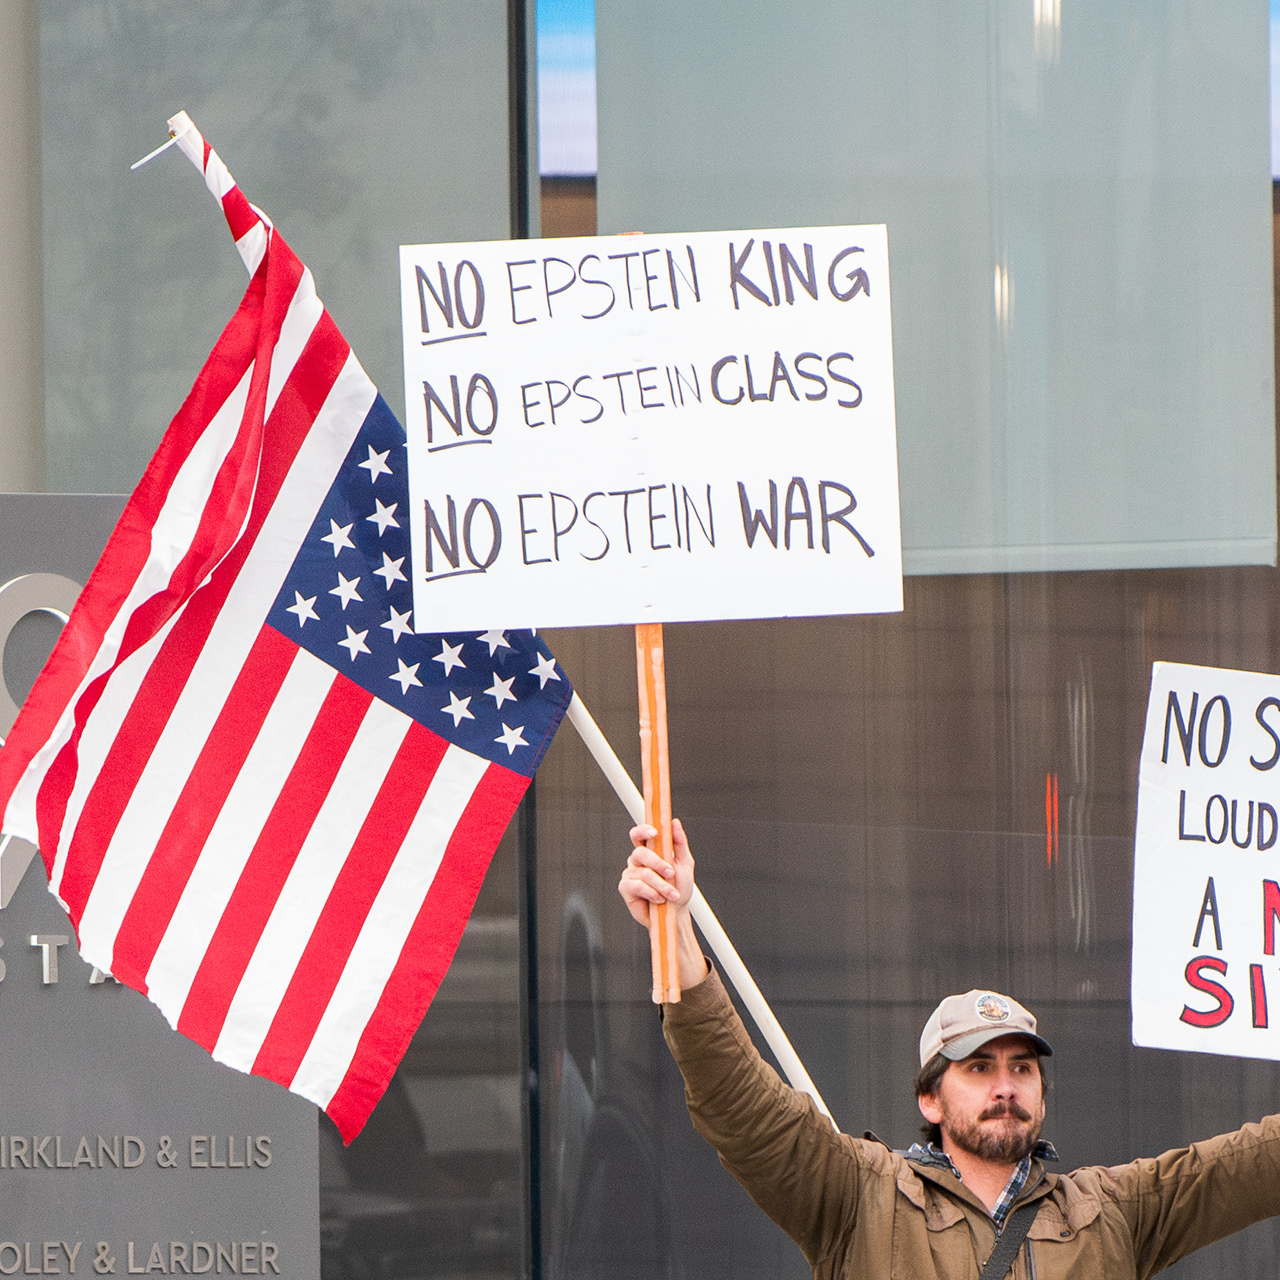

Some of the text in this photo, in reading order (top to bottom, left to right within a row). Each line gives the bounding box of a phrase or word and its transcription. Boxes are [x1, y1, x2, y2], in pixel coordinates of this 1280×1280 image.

[415, 259, 485, 334] NO
[728, 238, 871, 311] KING
[422, 350, 863, 444] NO EPSTEIN CLASS
[424, 475, 876, 572] NO EPSTEIN WAR
[1161, 690, 1232, 769] NO
[1192, 875, 1223, 951] A
[155, 1134, 180, 1169] &
[190, 1135, 274, 1169] ELLIS
[93, 1241, 117, 1275] &
[127, 1241, 282, 1276] LARDNER
